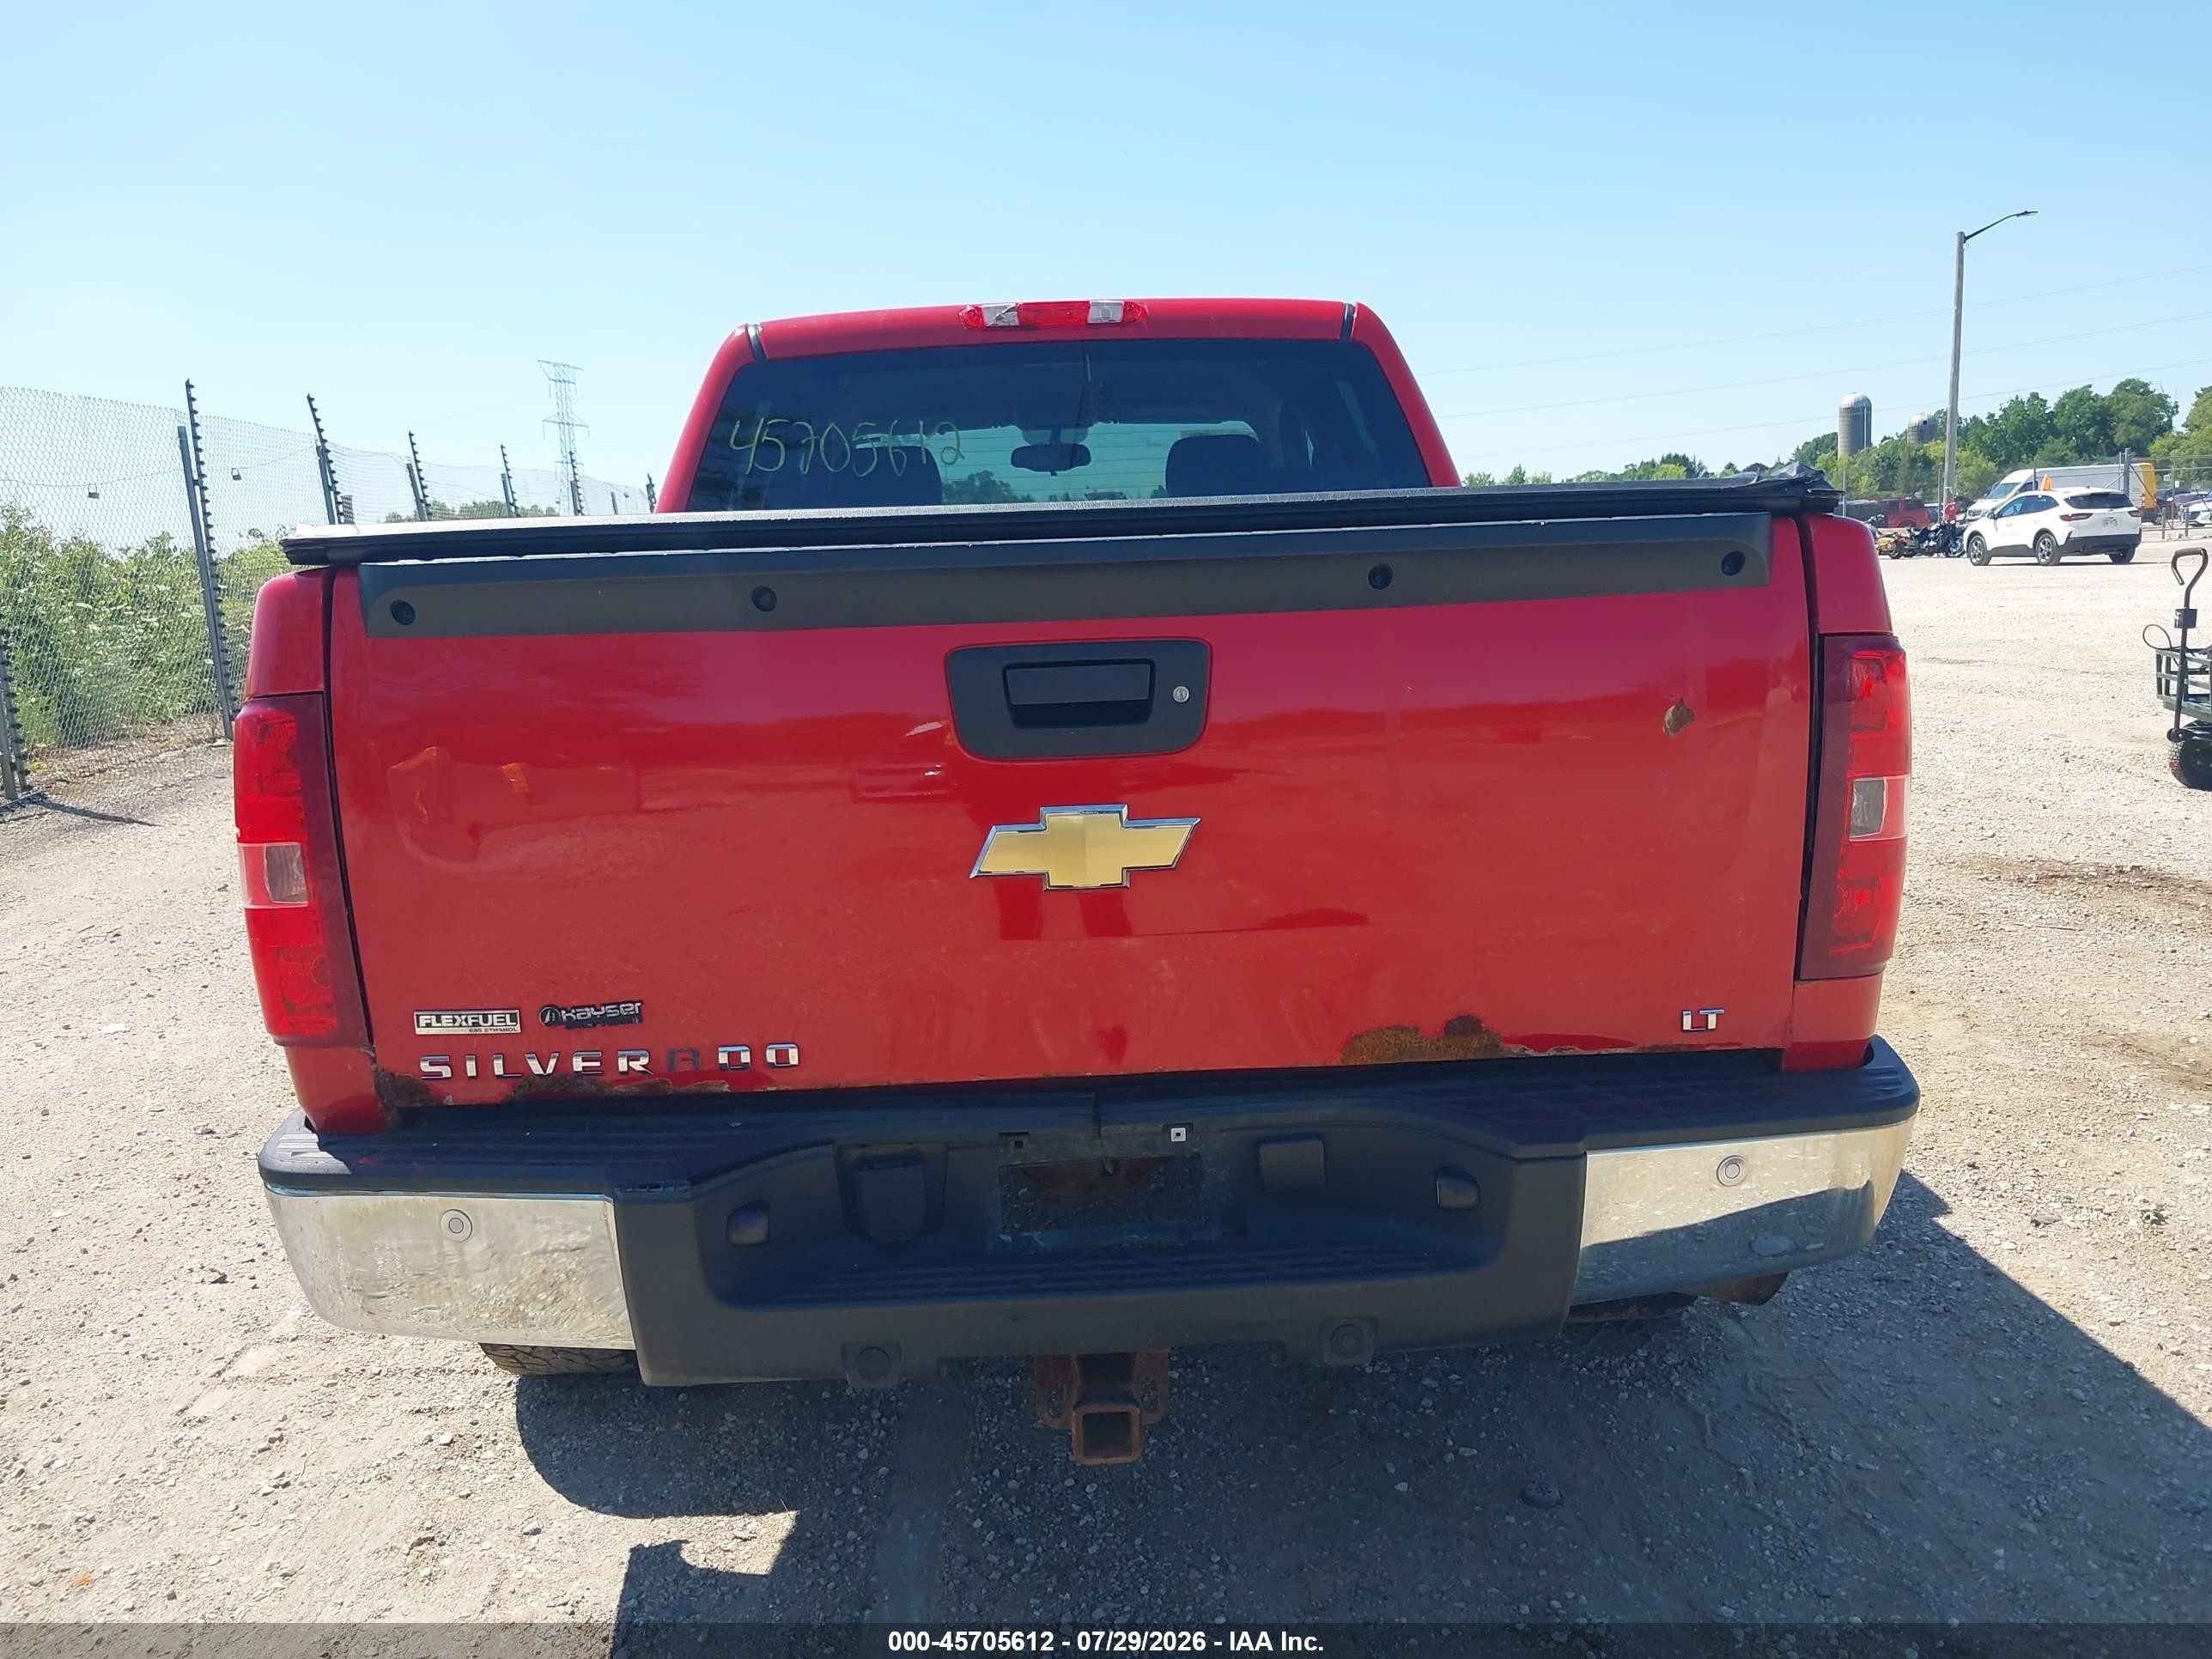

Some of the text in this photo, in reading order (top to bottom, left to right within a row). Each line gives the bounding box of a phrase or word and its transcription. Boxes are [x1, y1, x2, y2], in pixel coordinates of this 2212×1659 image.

[730, 417, 965, 477] 45705612
[418, 1014, 517, 1027] FLEXFUEL
[1682, 1008, 1724, 1031] LT
[419, 1042, 799, 1079] SILVERADO
